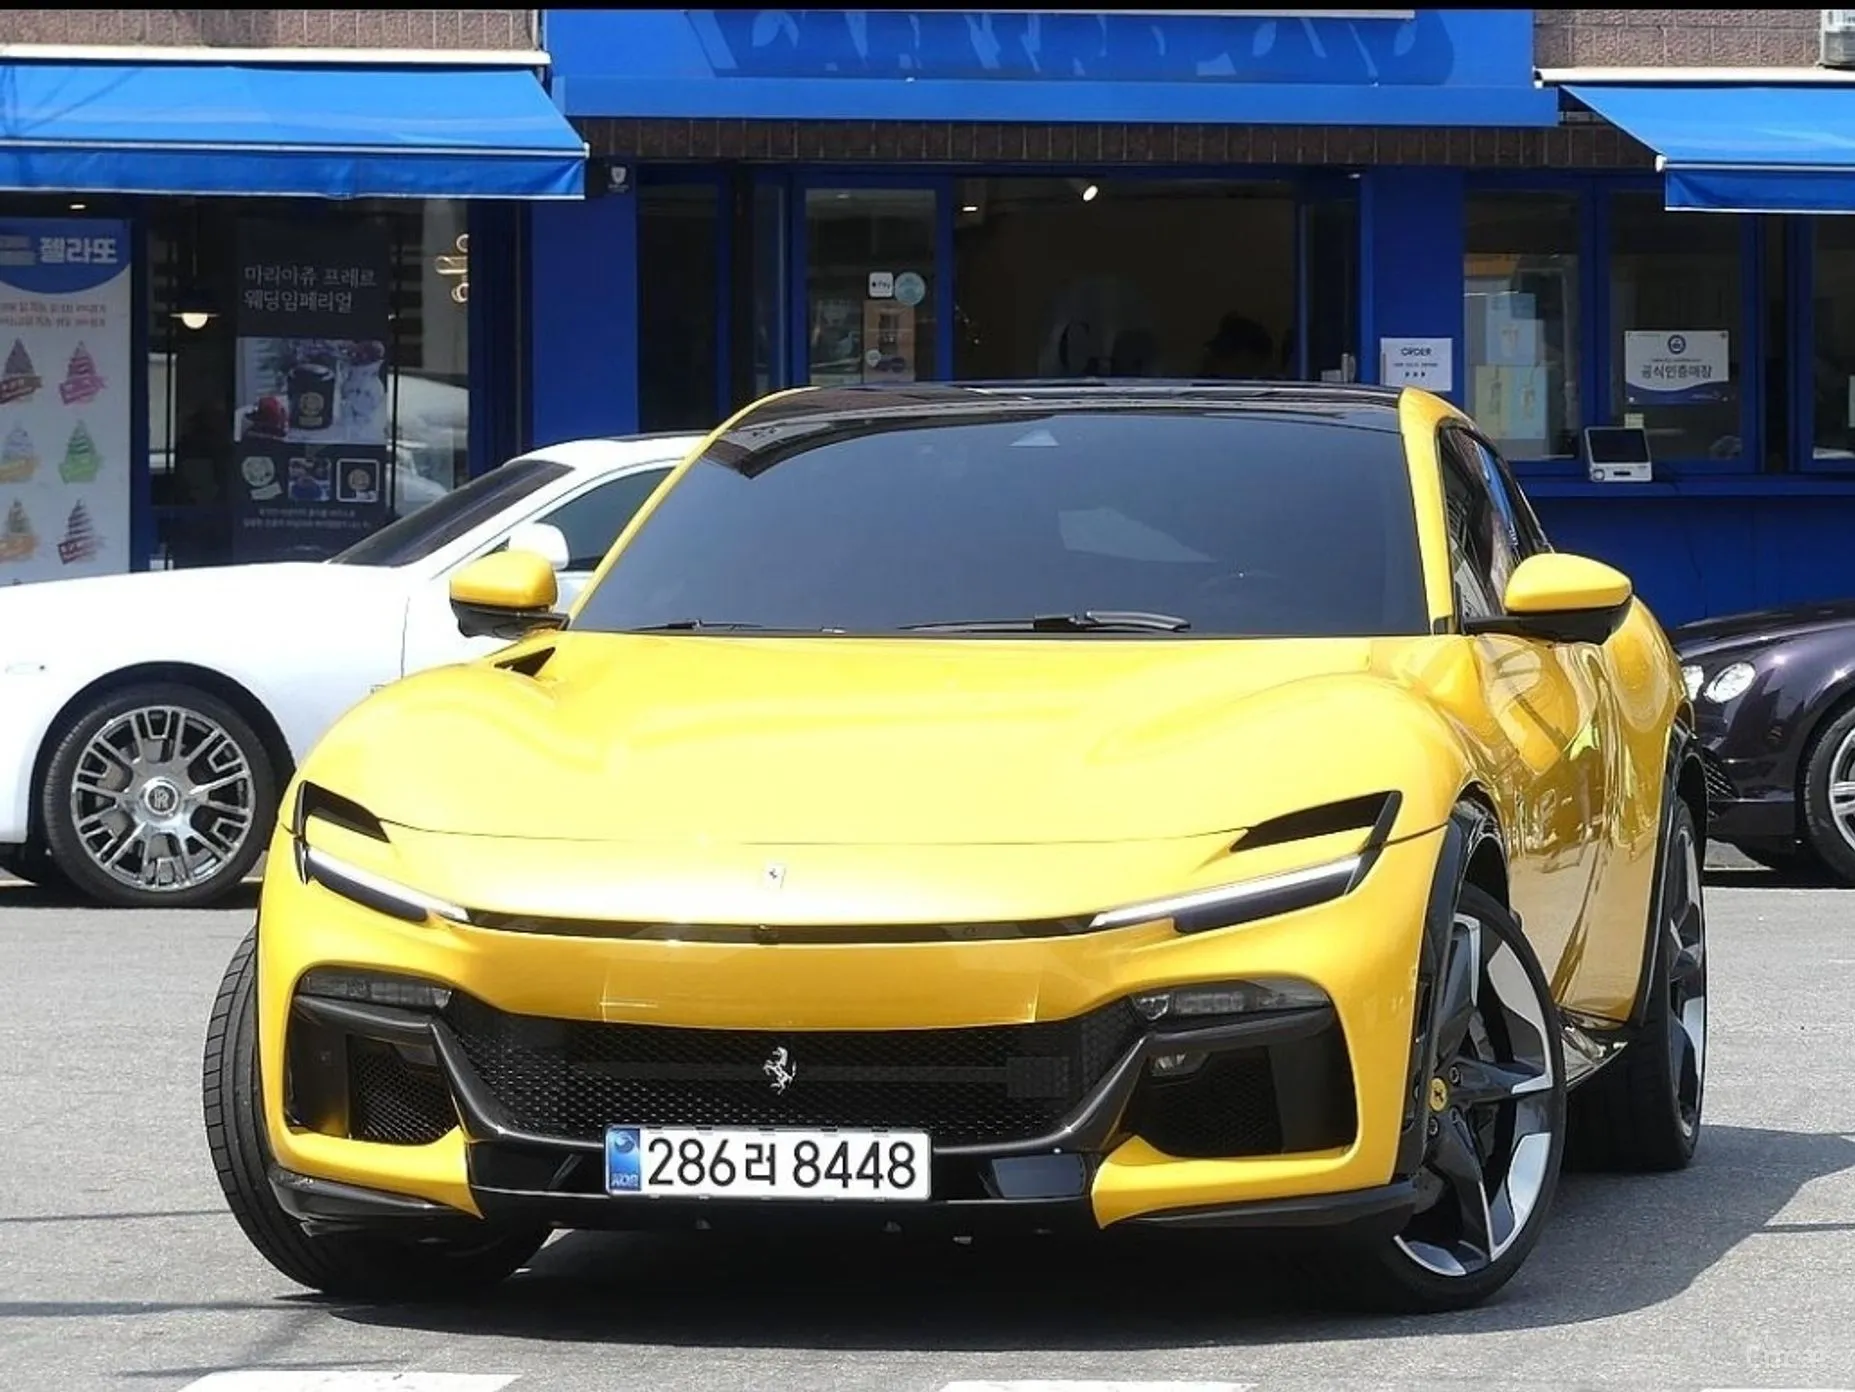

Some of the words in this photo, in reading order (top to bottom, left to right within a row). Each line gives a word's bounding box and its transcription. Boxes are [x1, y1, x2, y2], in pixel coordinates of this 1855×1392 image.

[40, 237, 118, 264] 젤라또
[323, 267, 377, 289] 프레르
[648, 1137, 776, 1187] 286러
[793, 1140, 916, 1189] 8448
